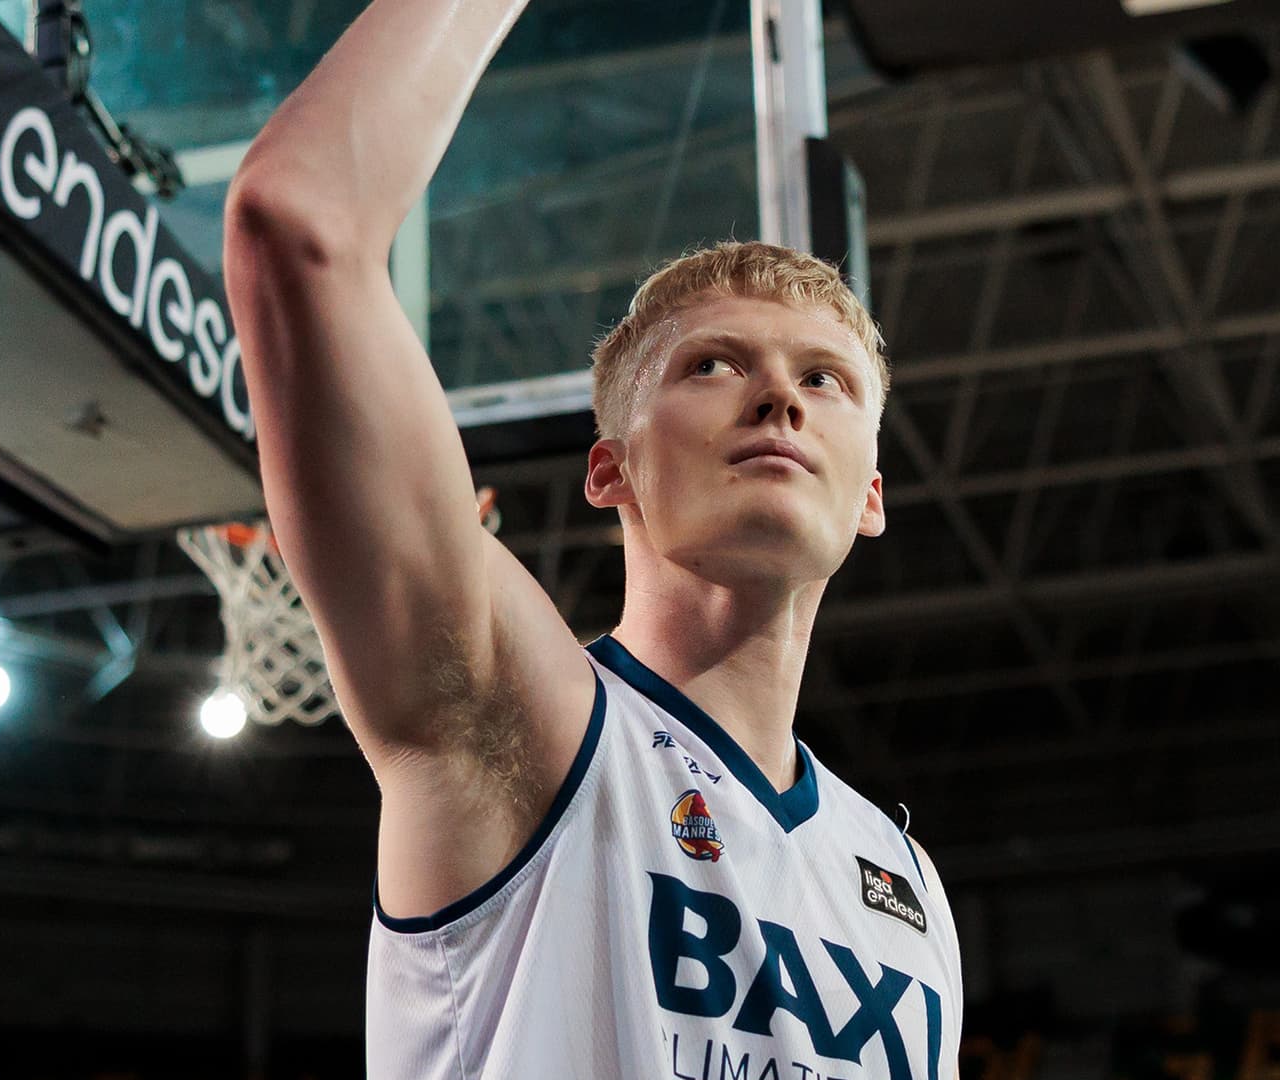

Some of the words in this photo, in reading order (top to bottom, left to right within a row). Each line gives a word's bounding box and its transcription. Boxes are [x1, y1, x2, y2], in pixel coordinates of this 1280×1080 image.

[672, 823, 721, 840] MANRES
[864, 869, 893, 895] liga
[867, 889, 924, 927] endesa
